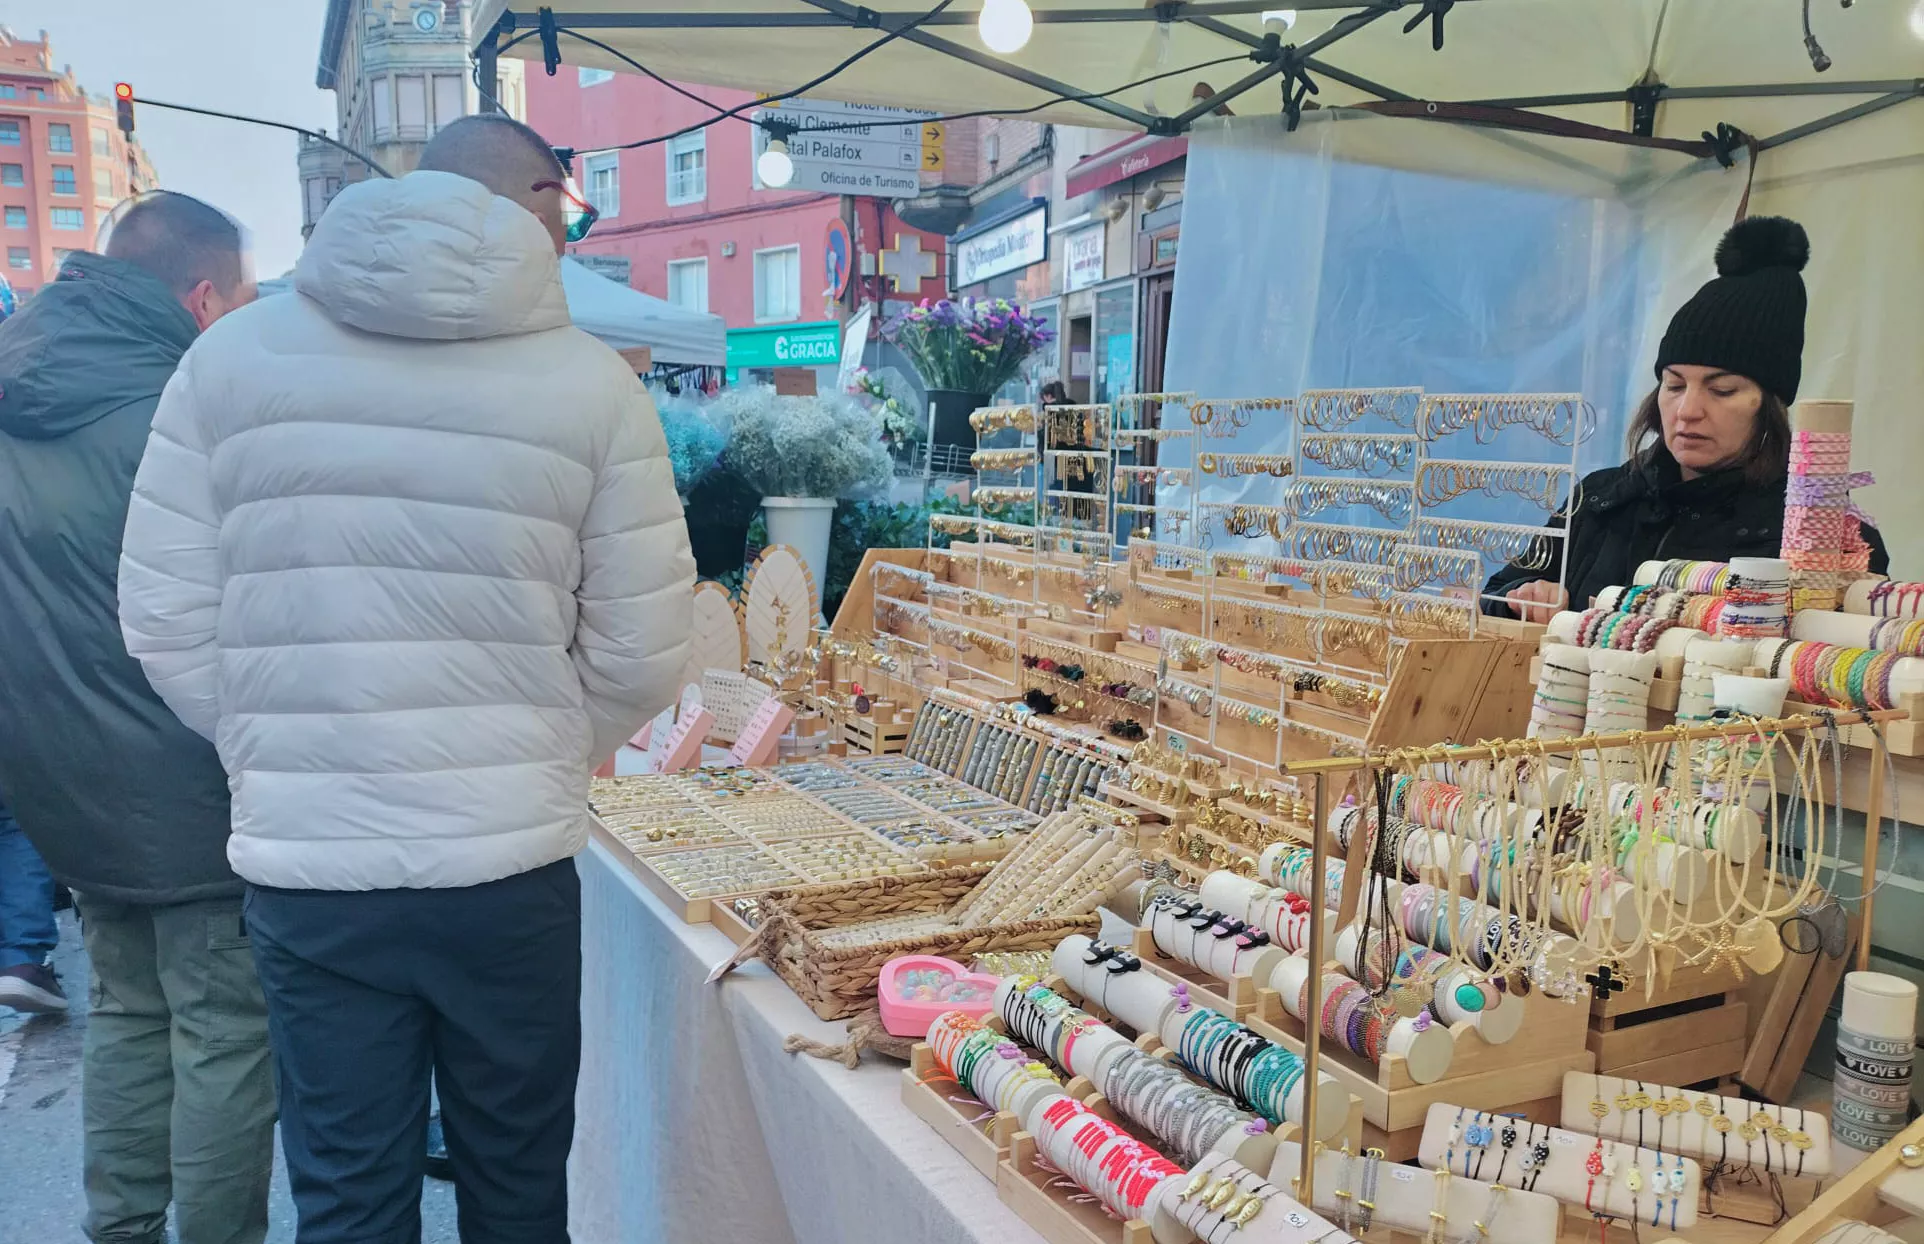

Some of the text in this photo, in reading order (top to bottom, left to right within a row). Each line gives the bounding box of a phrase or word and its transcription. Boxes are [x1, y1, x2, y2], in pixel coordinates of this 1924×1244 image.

[805, 115, 871, 135] Clemente
[764, 137, 862, 160] stal Palafox
[821, 171, 915, 189] Oficina de Turismo
[790, 341, 837, 359] GRACIA
[1869, 1039, 1907, 1054] LOVE
[1859, 1062, 1897, 1078] LOVE
[1860, 1087, 1898, 1102] LOVE
[1840, 1101, 1876, 1122] LOVE
[1843, 1127, 1880, 1147] LOVE
